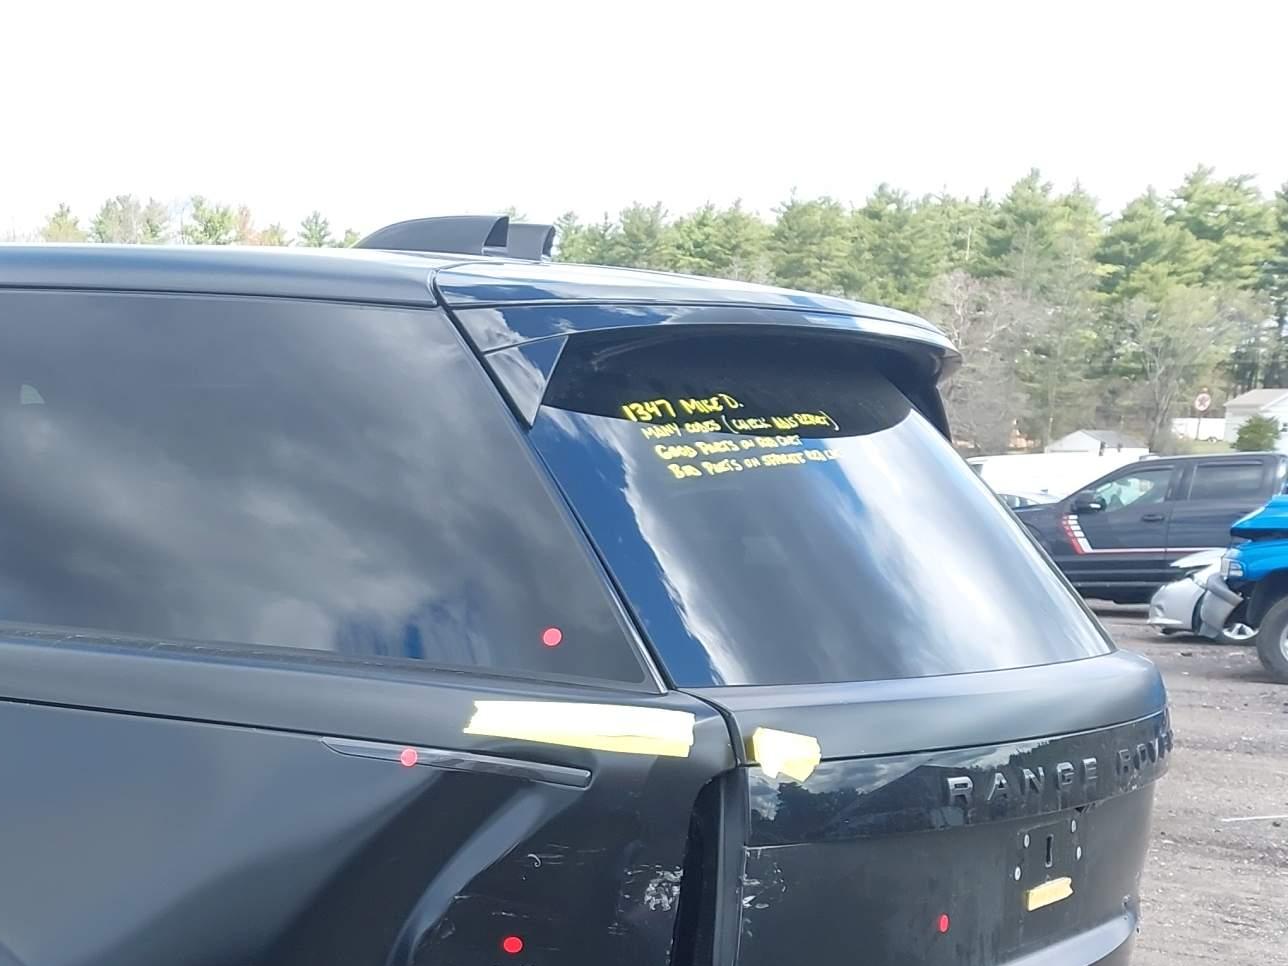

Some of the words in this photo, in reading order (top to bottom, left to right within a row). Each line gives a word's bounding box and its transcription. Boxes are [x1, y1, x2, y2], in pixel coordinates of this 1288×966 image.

[622, 399, 676, 422] 1347
[640, 422, 682, 439] MANY
[947, 756, 1099, 804] RANGE
